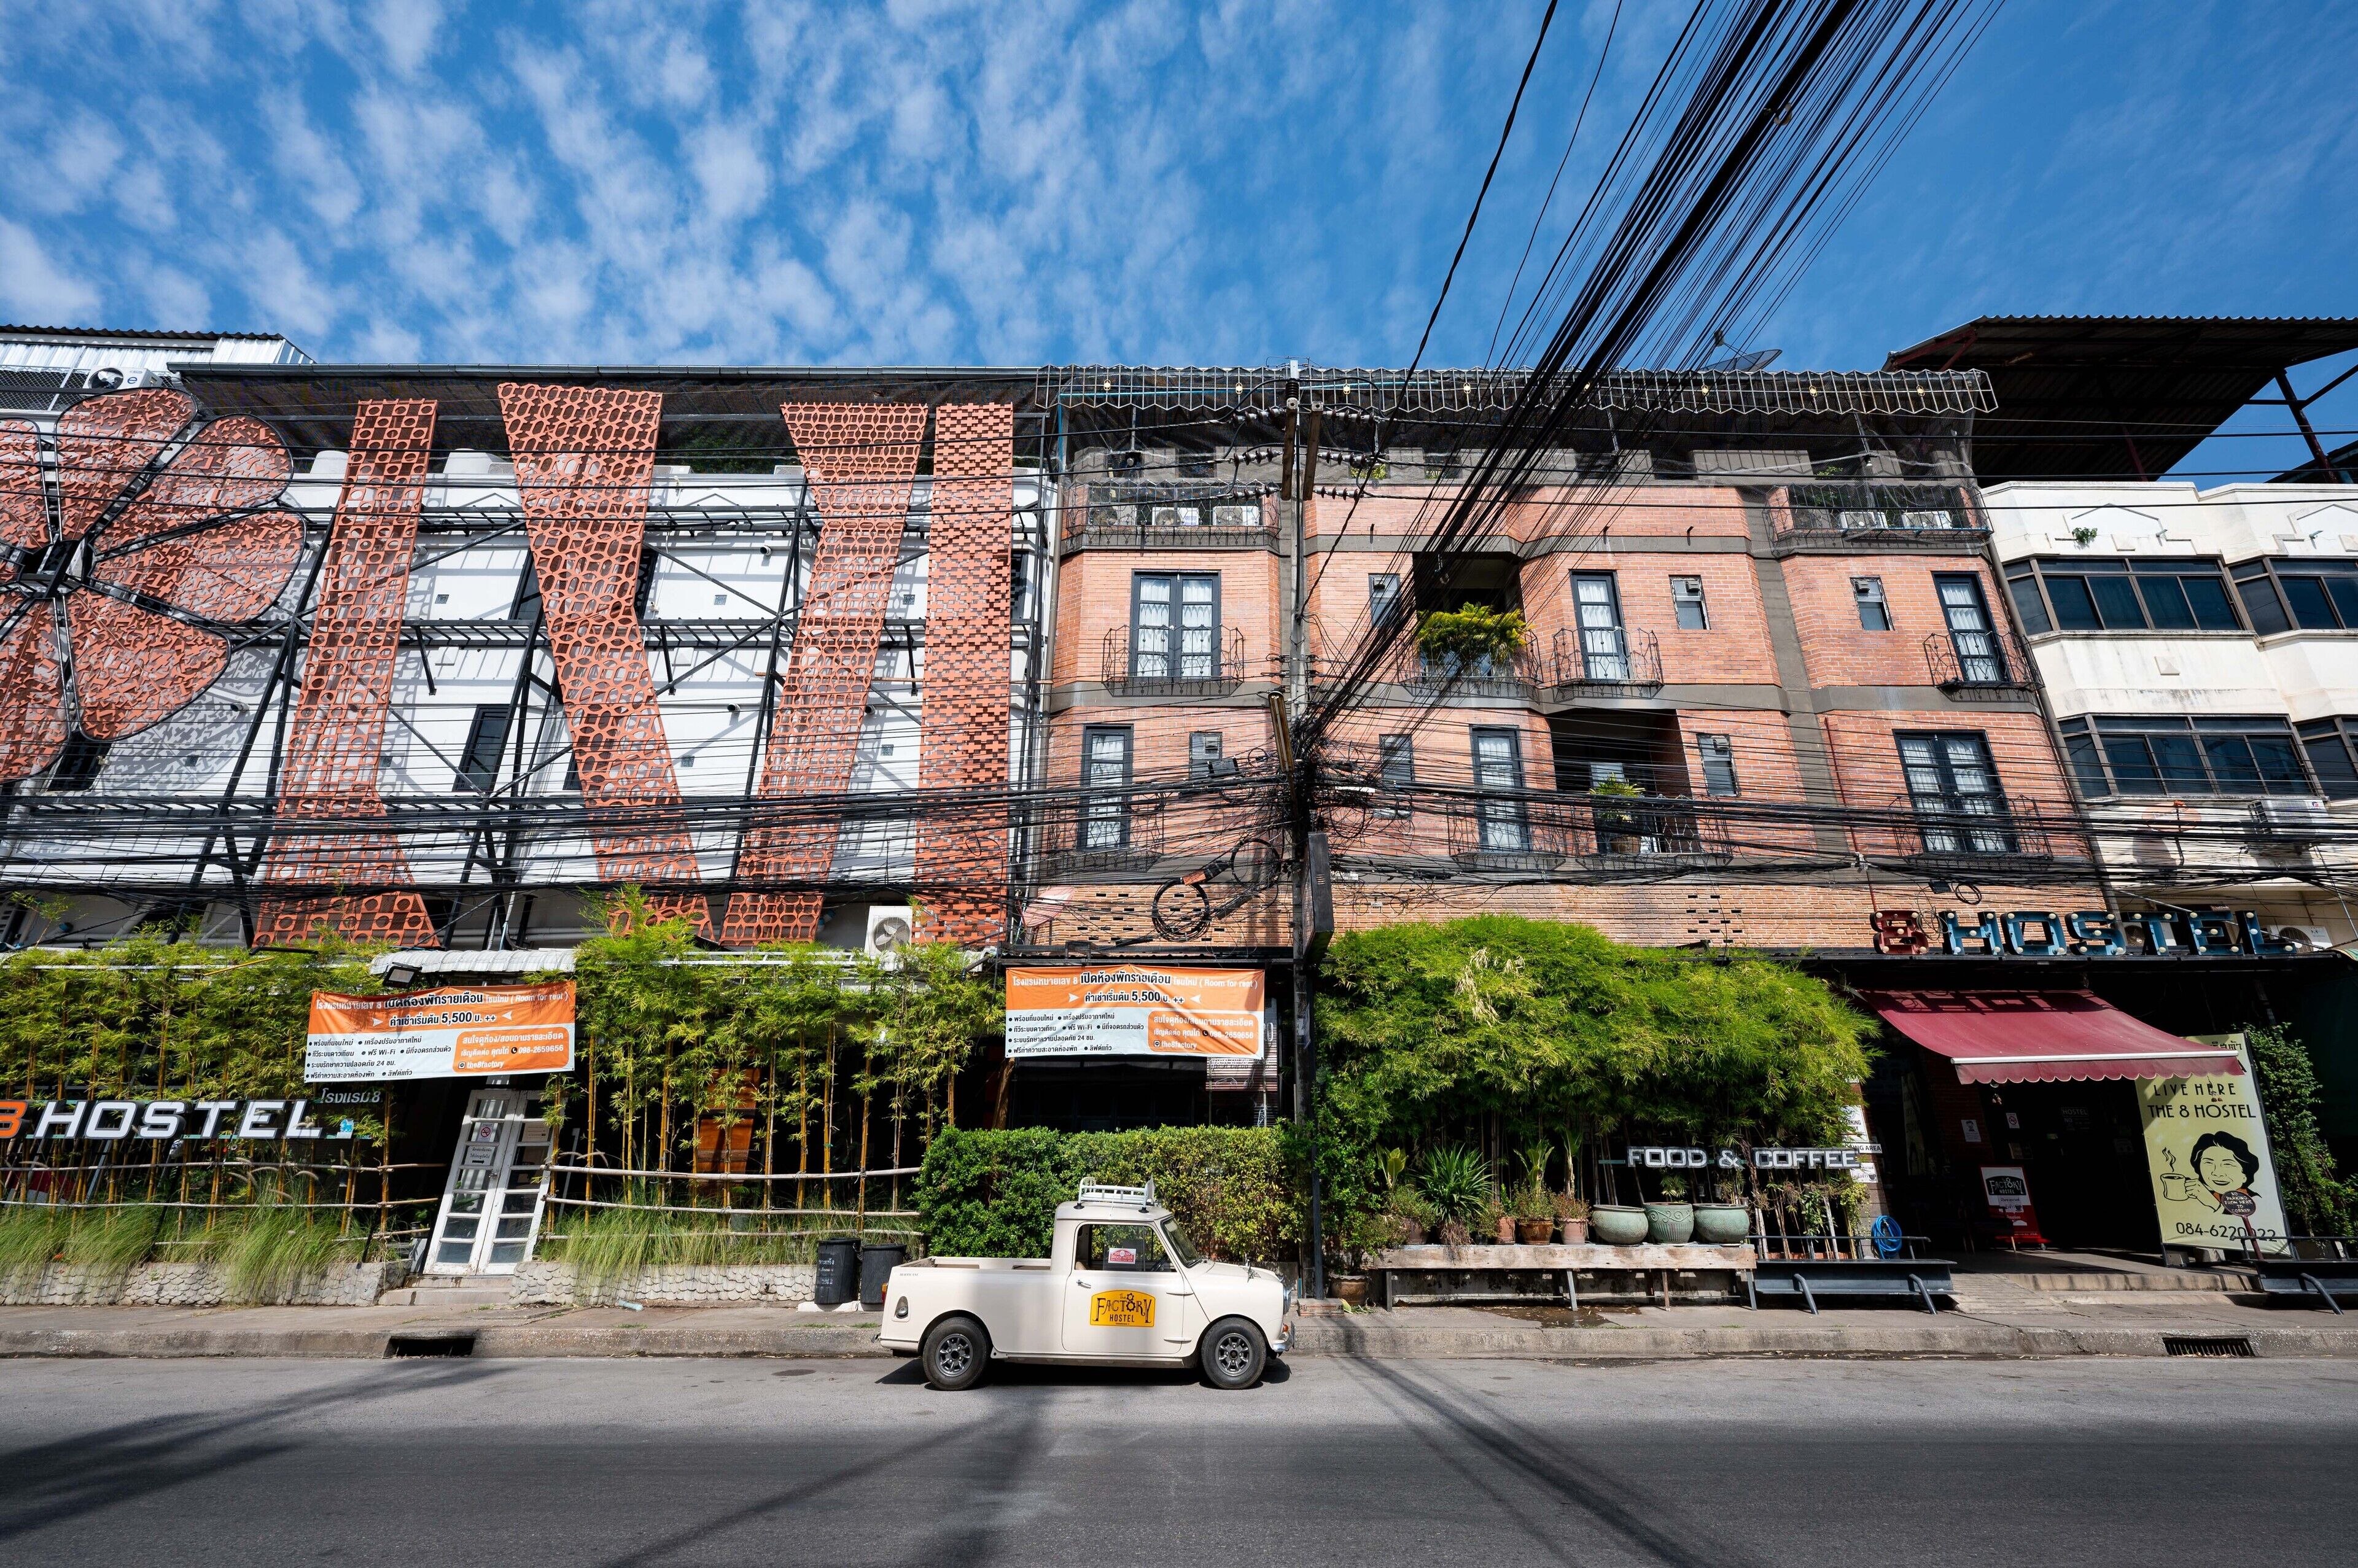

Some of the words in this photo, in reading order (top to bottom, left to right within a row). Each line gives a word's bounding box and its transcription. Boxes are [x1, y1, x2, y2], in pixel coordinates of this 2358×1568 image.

[1870, 909, 1929, 955] 8
[1939, 909, 2297, 955] HOSTEL
[1080, 971, 1171, 984] เปิดห้องพักรายเดือน
[1085, 990, 1129, 1002] ค่าเช่าเริ่มต้น
[1132, 991, 1161, 1003] 5,500
[442, 1012, 472, 1025] 5,500
[518, 1044, 564, 1054] 098-2659656
[467, 1060, 505, 1069] the8factory
[2154, 1084, 2188, 1096] LIVE
[2195, 1083, 2236, 1095] HERE
[2147, 1104, 2175, 1118] THE
[2179, 1104, 2190, 1118] 8
[2194, 1104, 2257, 1118] HOSTEL
[33, 1100, 324, 1139] HOSTEL
[1627, 1146, 1709, 1168] FOOD
[1719, 1149, 1741, 1168] &
[1753, 1147, 1861, 1170] COFFEE
[1989, 1179, 2025, 1195] FACTORY
[1092, 1297, 1153, 1324] FACTORY
[1110, 1314, 1135, 1322] HOSTEL
